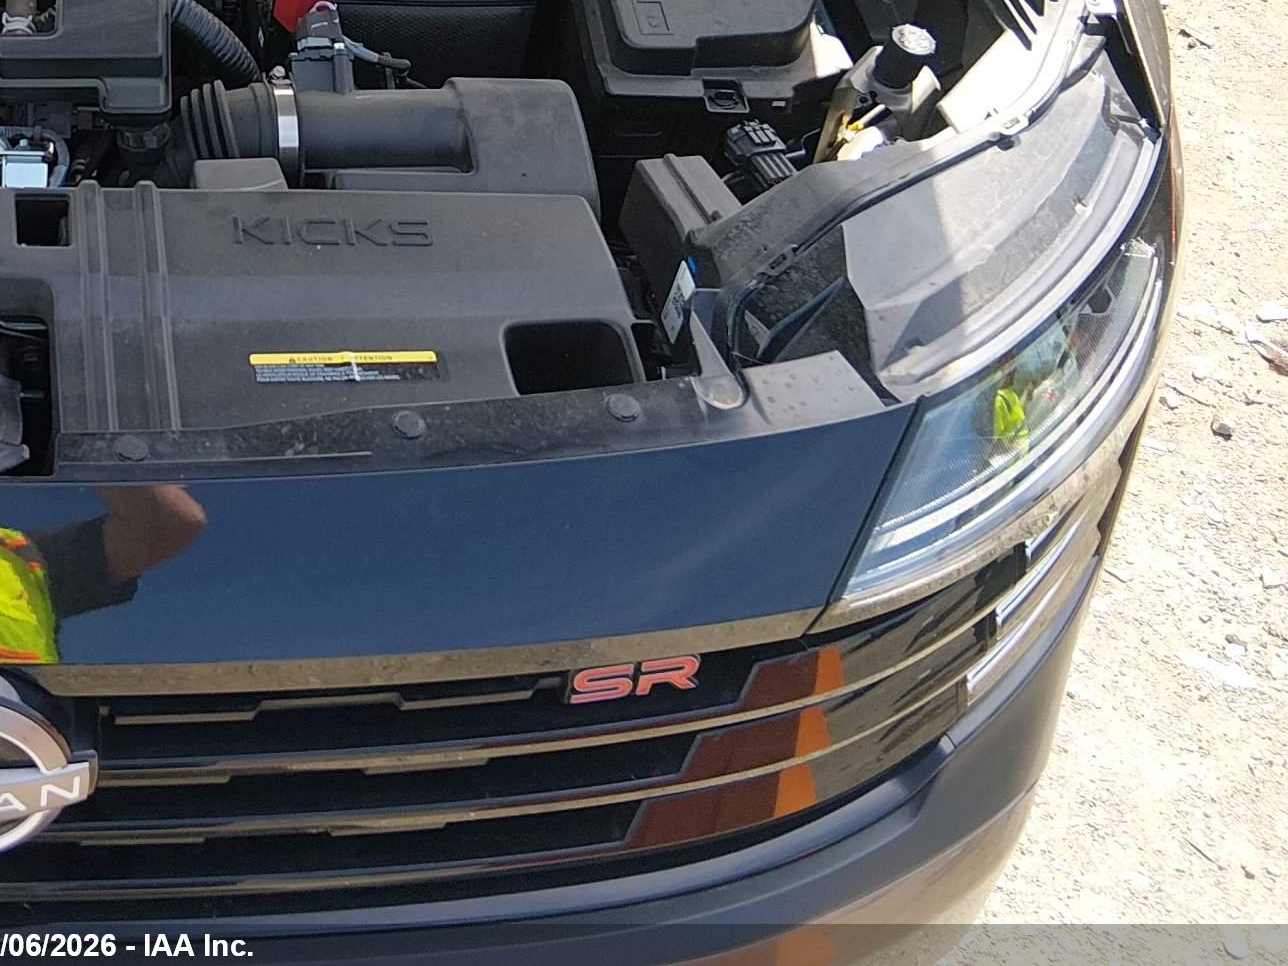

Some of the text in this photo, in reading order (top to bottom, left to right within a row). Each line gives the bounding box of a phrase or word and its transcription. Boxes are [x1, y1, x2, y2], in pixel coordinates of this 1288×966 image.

[232, 216, 434, 247] KICKS
[296, 355, 333, 363] CAUTION
[569, 654, 701, 704] SR
